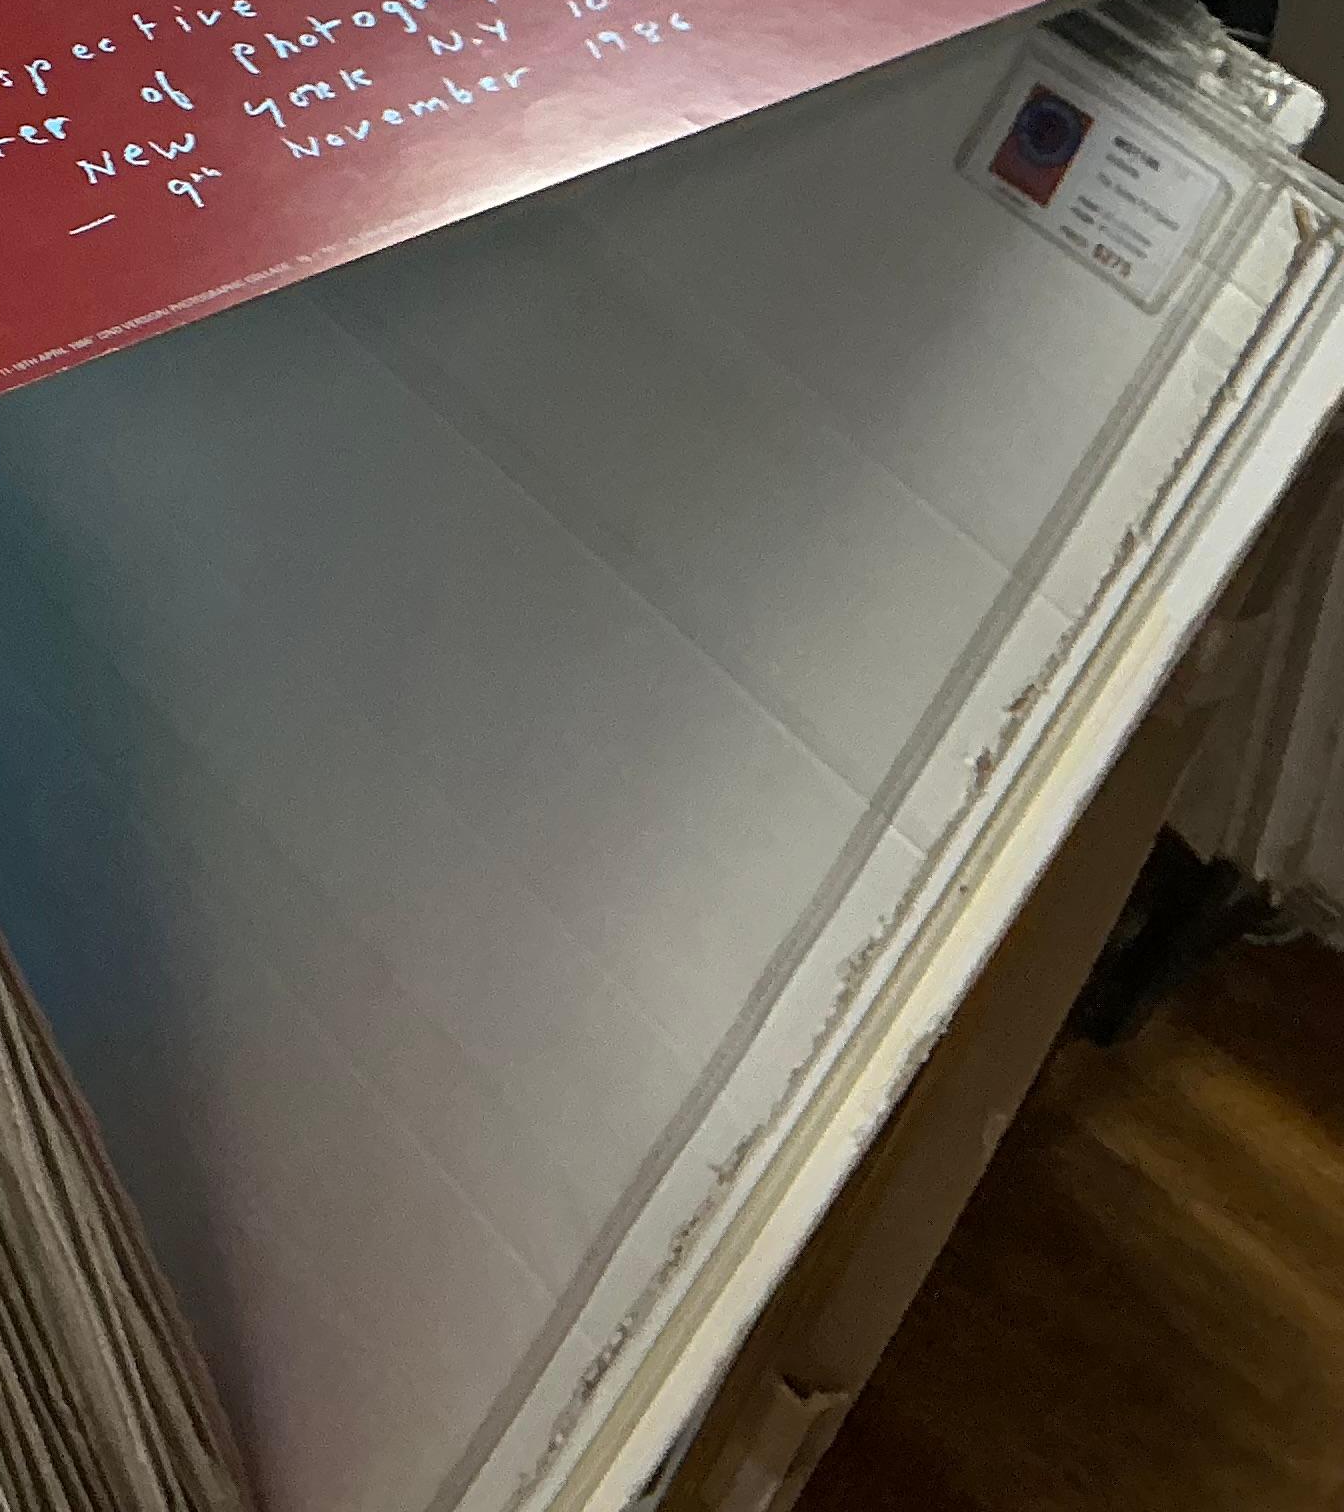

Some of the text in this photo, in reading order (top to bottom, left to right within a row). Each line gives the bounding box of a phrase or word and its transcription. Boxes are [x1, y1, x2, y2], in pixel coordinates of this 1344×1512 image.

[140, 71, 194, 111] of
[280, 67, 530, 159] November
[585, 11, 692, 60] 1986
[76, 132, 197, 184] New
